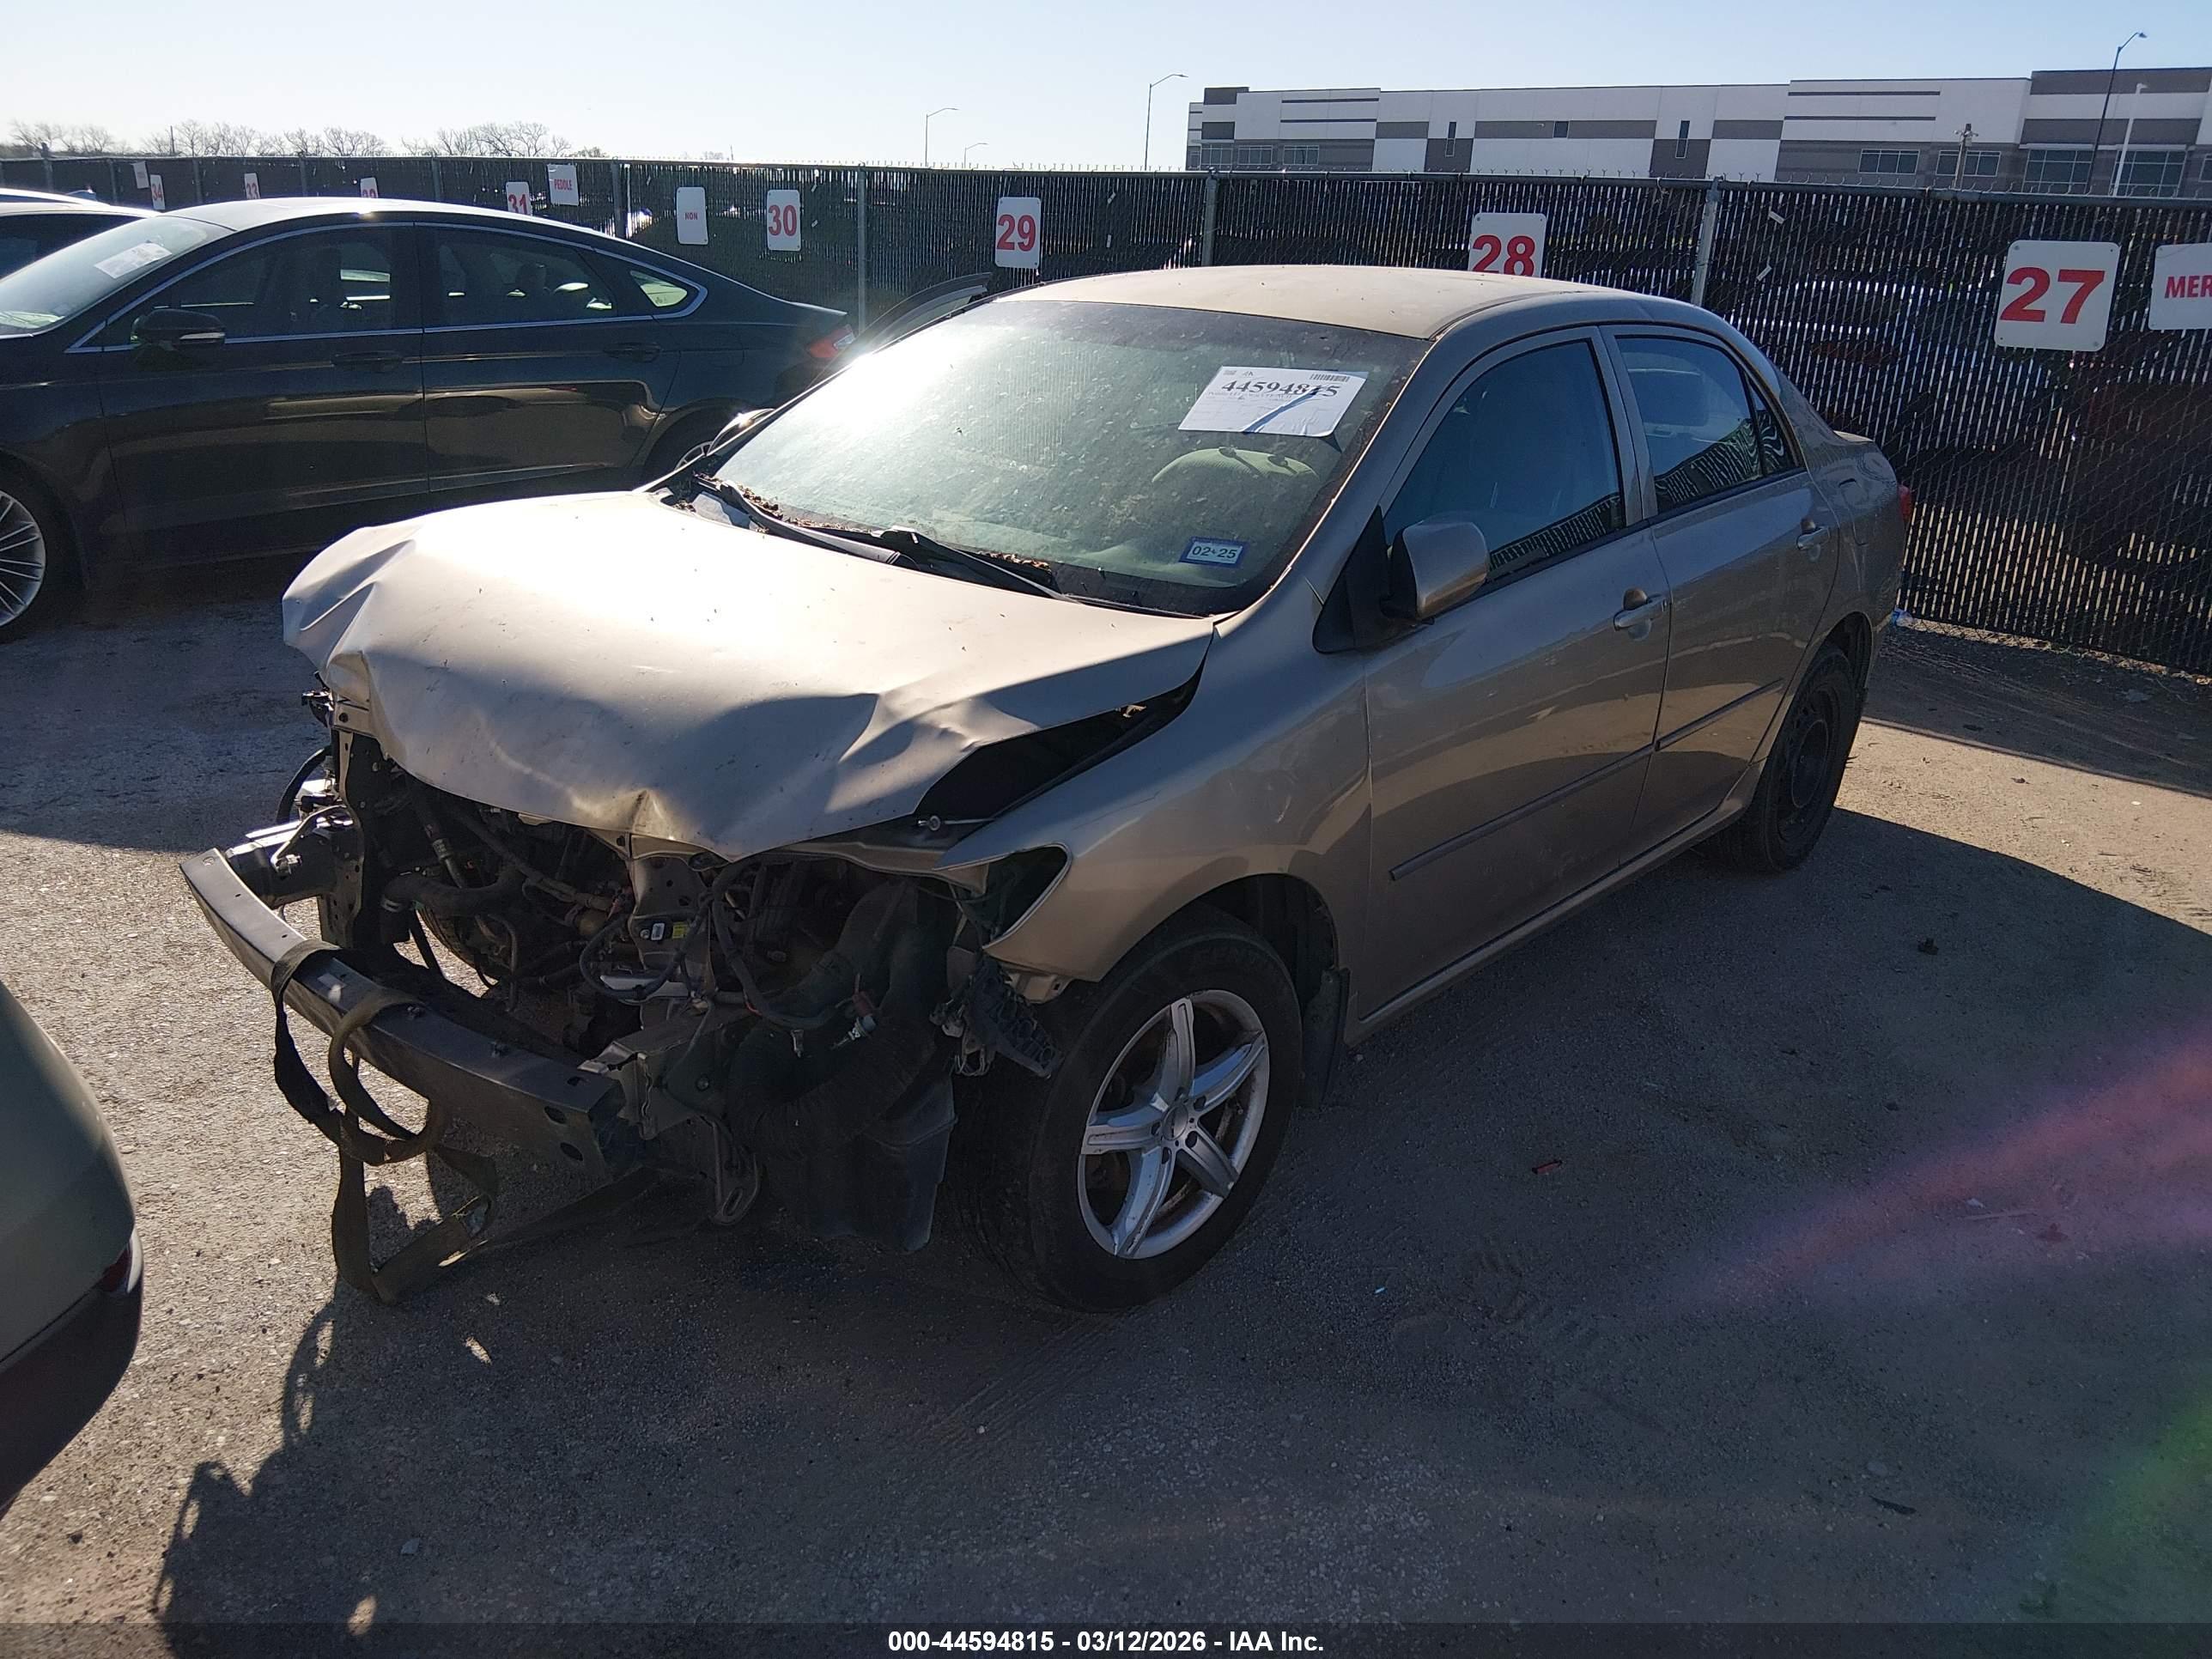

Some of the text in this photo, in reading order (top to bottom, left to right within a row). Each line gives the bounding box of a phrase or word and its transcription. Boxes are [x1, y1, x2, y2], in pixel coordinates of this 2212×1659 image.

[152, 184, 163, 201] 34
[508, 193, 528, 215] 31
[684, 212, 698, 221] NON
[769, 204, 797, 237] 30
[997, 214, 1036, 252] 29
[1472, 234, 1535, 277] 28
[2000, 266, 2106, 325] 27
[2164, 275, 2212, 299] MER
